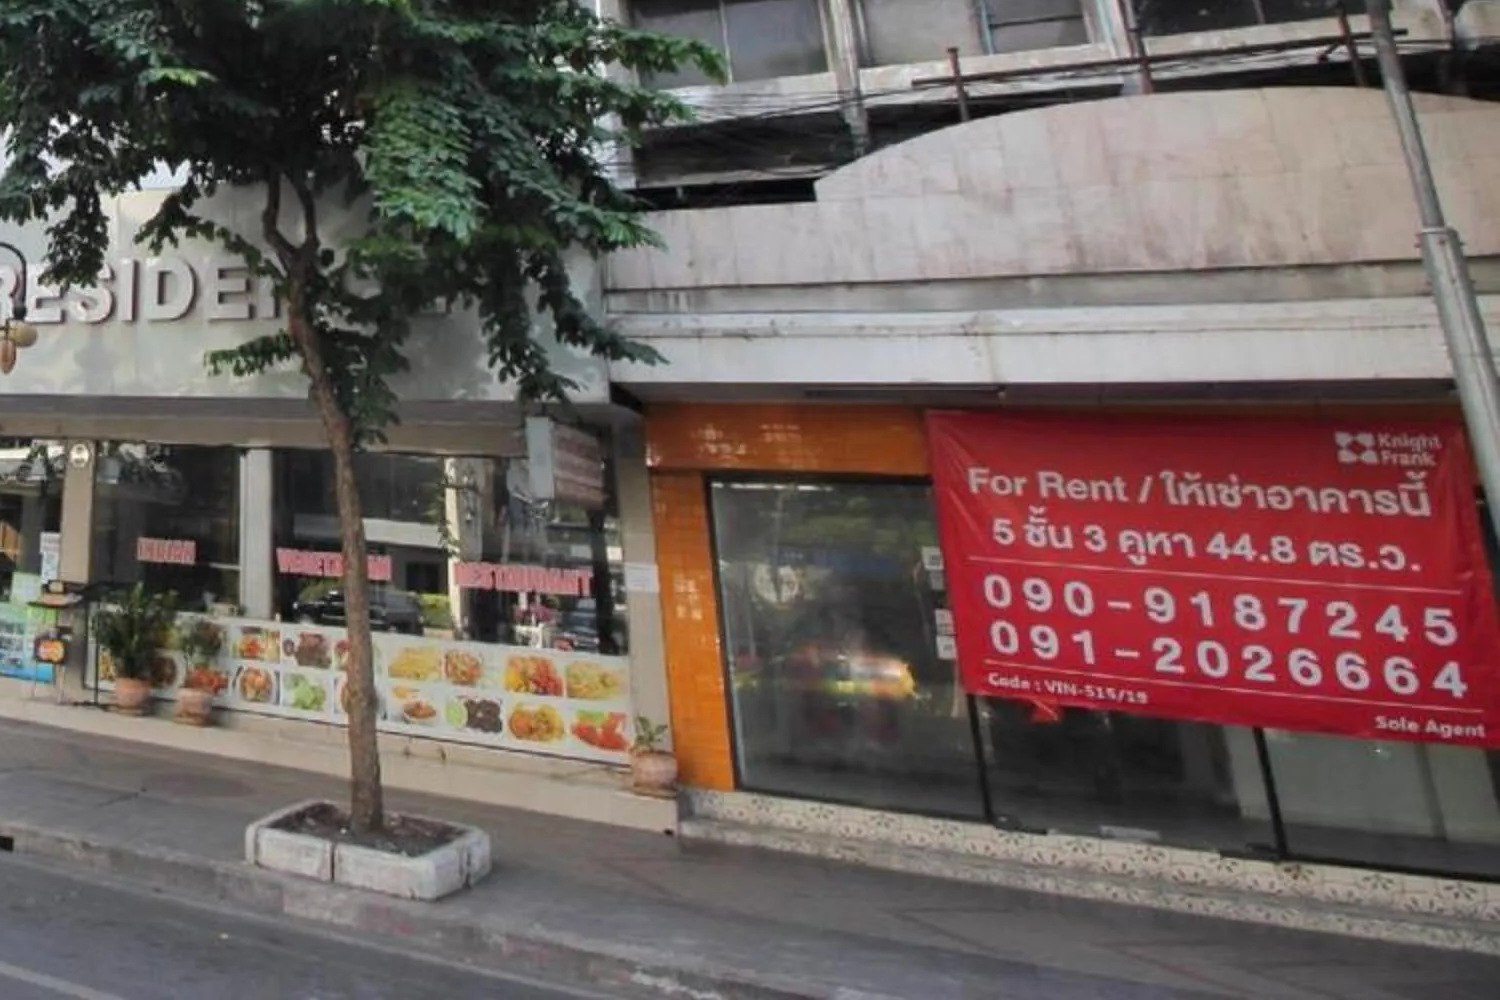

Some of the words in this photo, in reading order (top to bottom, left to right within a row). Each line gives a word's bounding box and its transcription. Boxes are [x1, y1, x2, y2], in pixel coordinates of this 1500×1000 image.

[1377, 431, 1442, 451] Knight
[1380, 450, 1438, 467] Frank
[967, 467, 1028, 497] For
[1037, 470, 1130, 503] Rent
[1159, 468, 1432, 517] ให้เช่าอาคารนี้
[992, 517, 1016, 545] 5
[1022, 505, 1074, 550] ชั้น
[1083, 525, 1107, 553] 3
[1118, 528, 1196, 566] คูหา
[1206, 531, 1297, 565] 44.8
[1307, 540, 1422, 572] ตร.ว.
[987, 671, 1031, 691] Code
[1374, 714, 1420, 734] Sole
[1425, 718, 1487, 739] Agent
